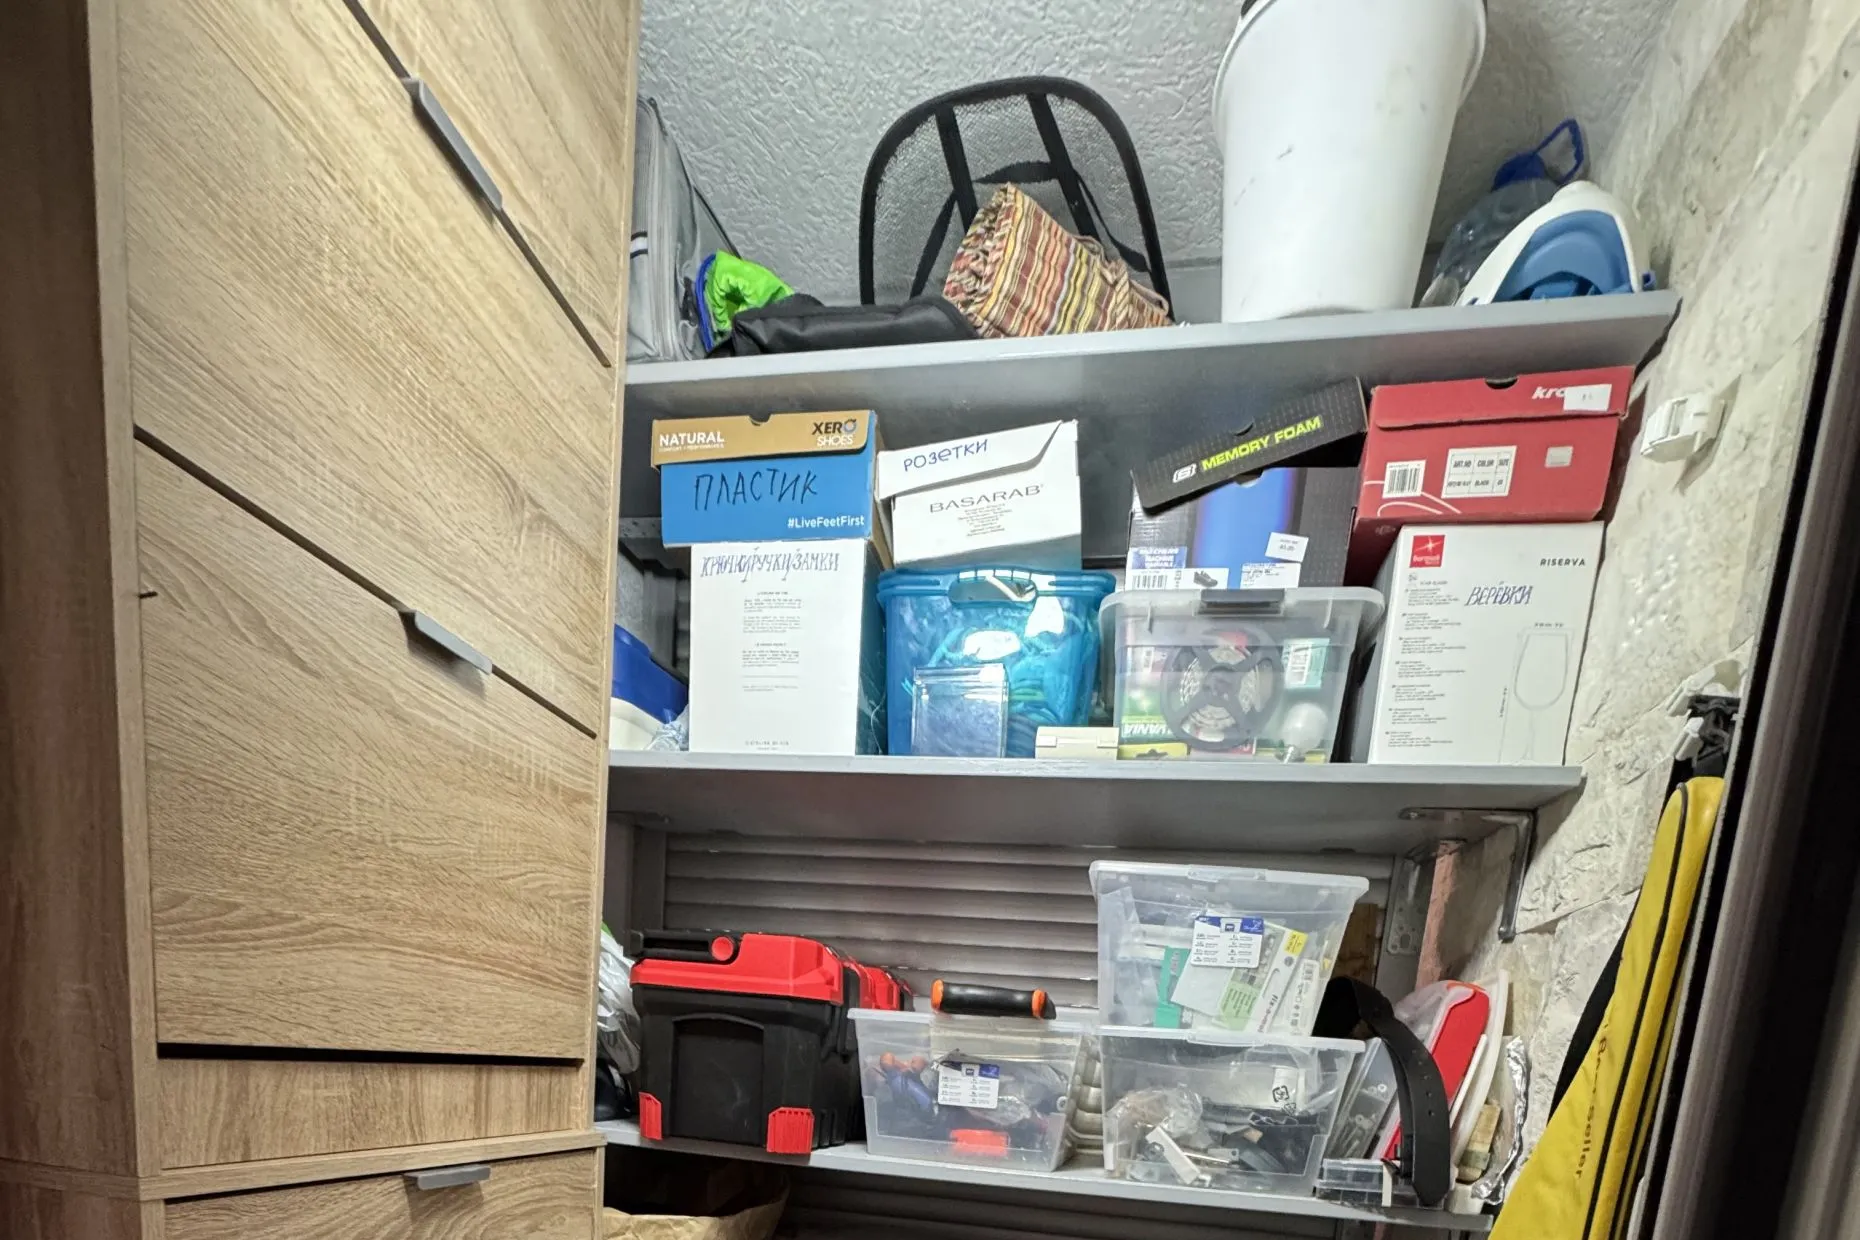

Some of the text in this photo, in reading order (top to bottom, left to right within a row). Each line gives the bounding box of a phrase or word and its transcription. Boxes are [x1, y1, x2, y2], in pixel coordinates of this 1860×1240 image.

[812, 418, 858, 435] XERO
[659, 431, 725, 447] NATURAL
[816, 434, 854, 447] SHOES
[1202, 435, 1270, 471] MEMORY
[1274, 416, 1322, 444] FOAM
[694, 468, 818, 511] ПЛАСТИК
[929, 485, 1042, 514] BASARAB
[787, 514, 865, 529] #LiveFeetFirst
[1540, 558, 1586, 567] RISERVA
